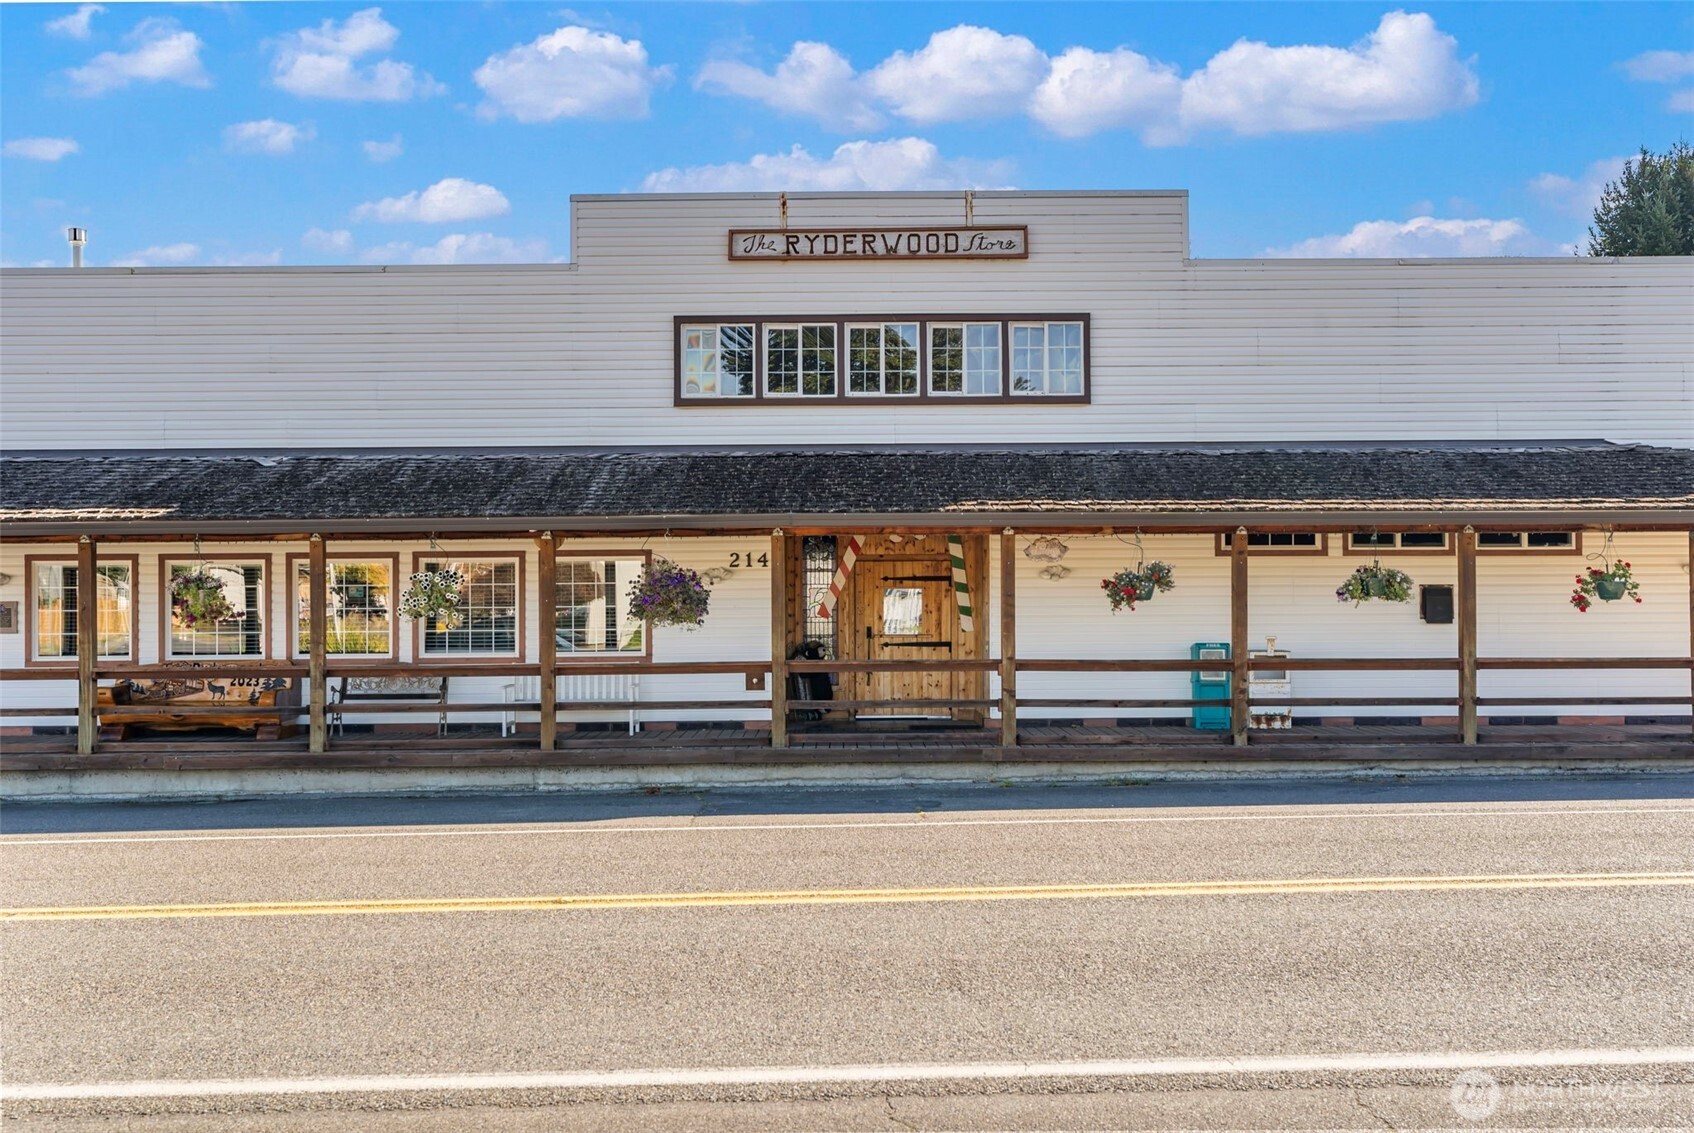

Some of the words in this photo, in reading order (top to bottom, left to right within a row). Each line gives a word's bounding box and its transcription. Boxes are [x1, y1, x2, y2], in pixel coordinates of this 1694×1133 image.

[743, 233, 776, 254] The
[784, 232, 960, 255] RYDERWOOD
[962, 232, 1016, 252] Store
[729, 551, 769, 568] 214
[230, 677, 260, 687] 2023
